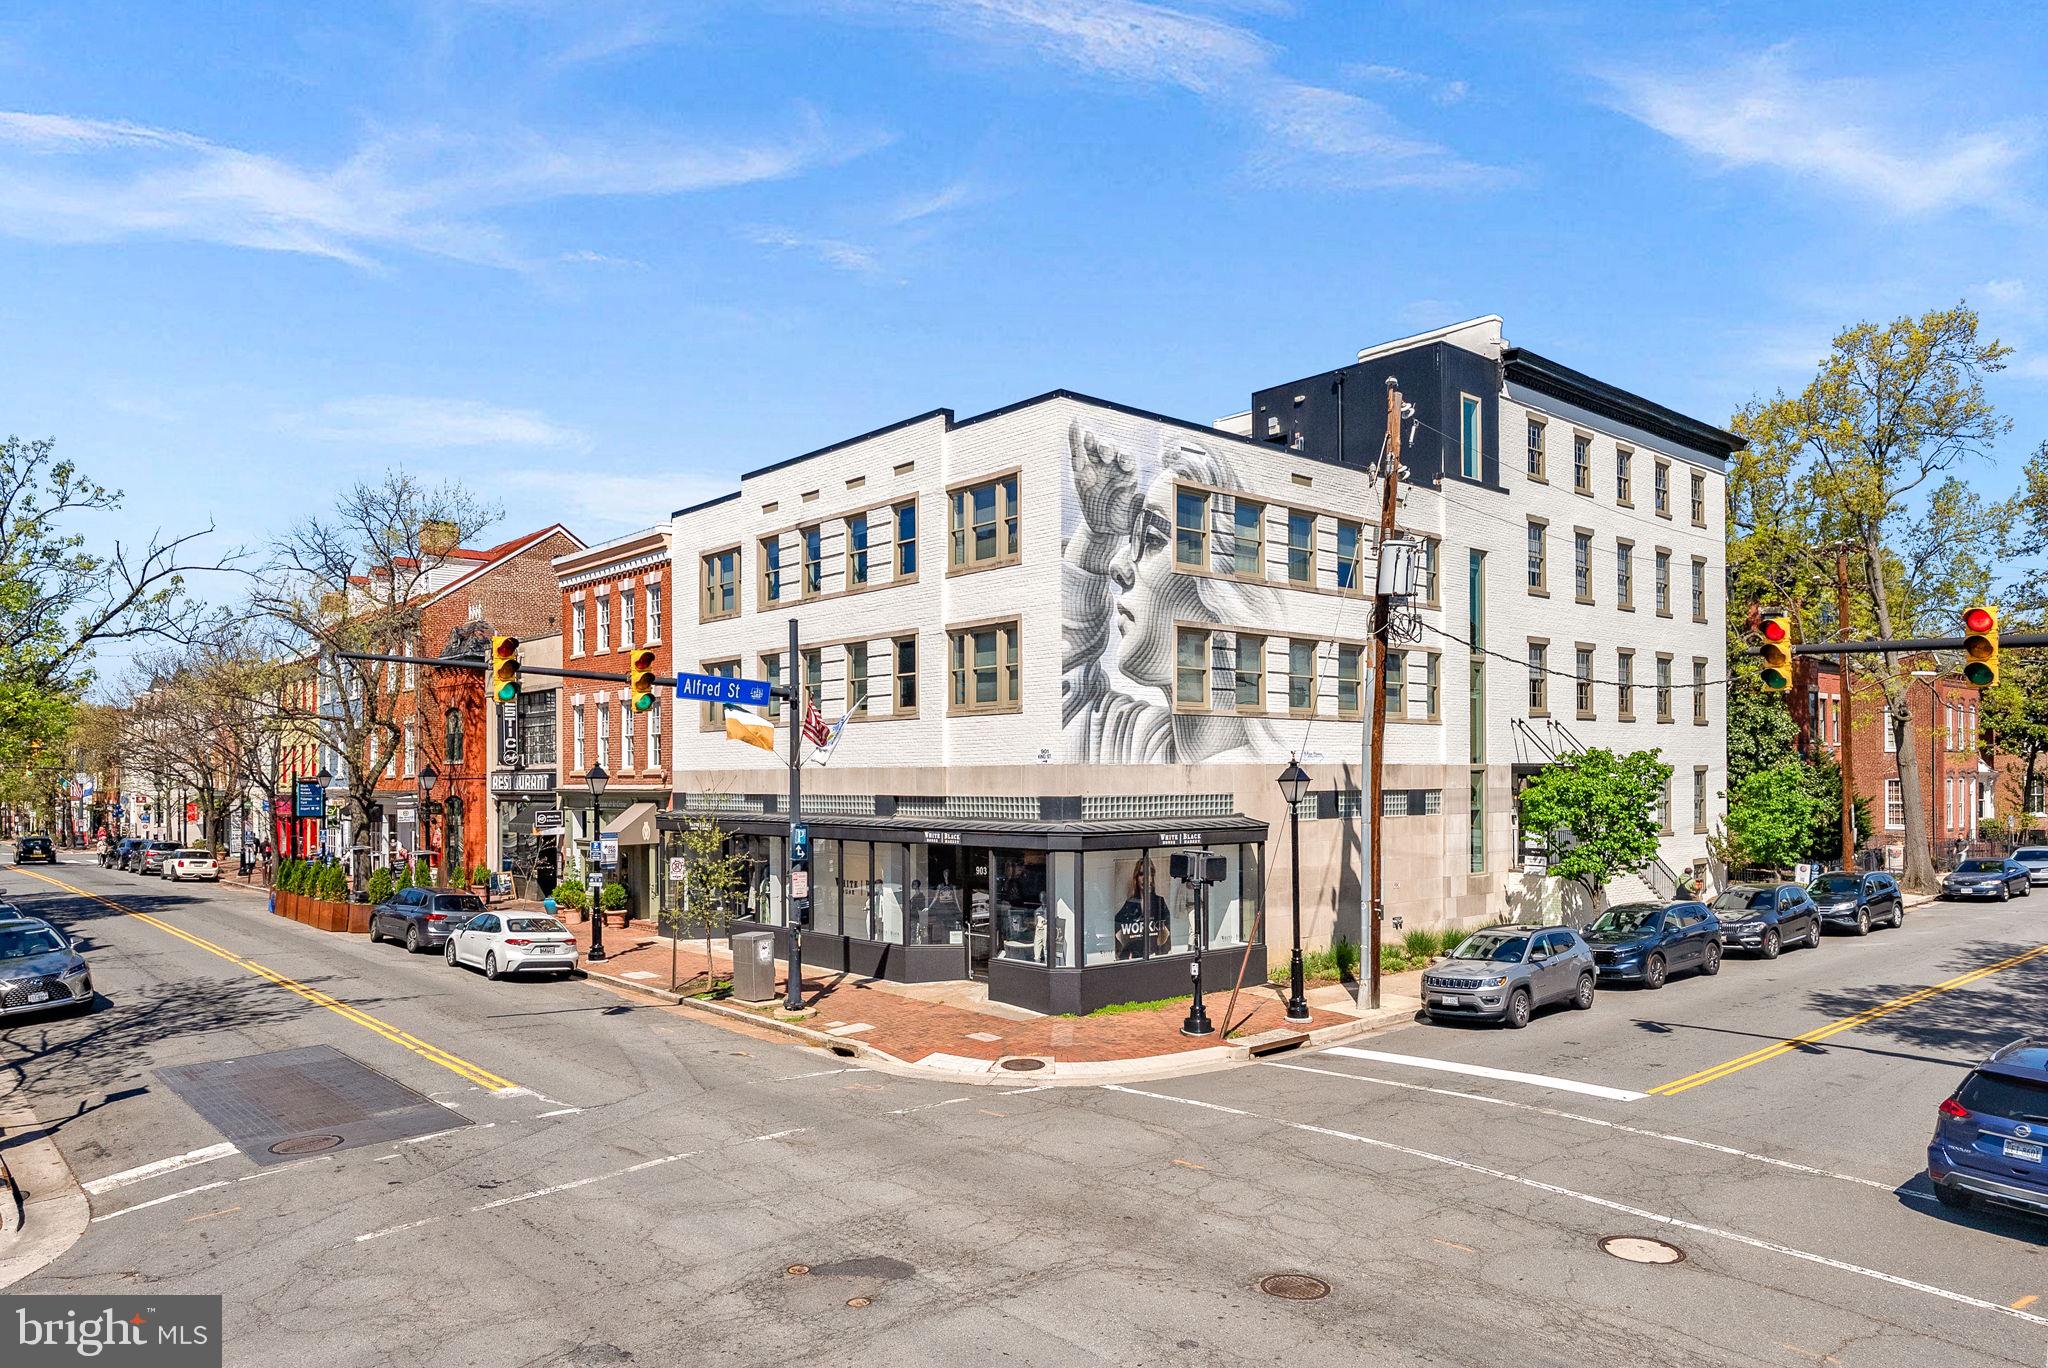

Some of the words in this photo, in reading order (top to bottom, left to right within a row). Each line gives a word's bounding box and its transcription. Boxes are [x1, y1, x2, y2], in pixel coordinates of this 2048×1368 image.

[683, 678, 721, 697] Alfred
[727, 682, 740, 699] St
[491, 774, 549, 791] RESTURANT
[924, 831, 941, 839] WHITE
[943, 832, 960, 840] BLACK
[1160, 833, 1179, 841] WHITE
[1182, 832, 1202, 840] BLACK
[975, 866, 988, 876] 903
